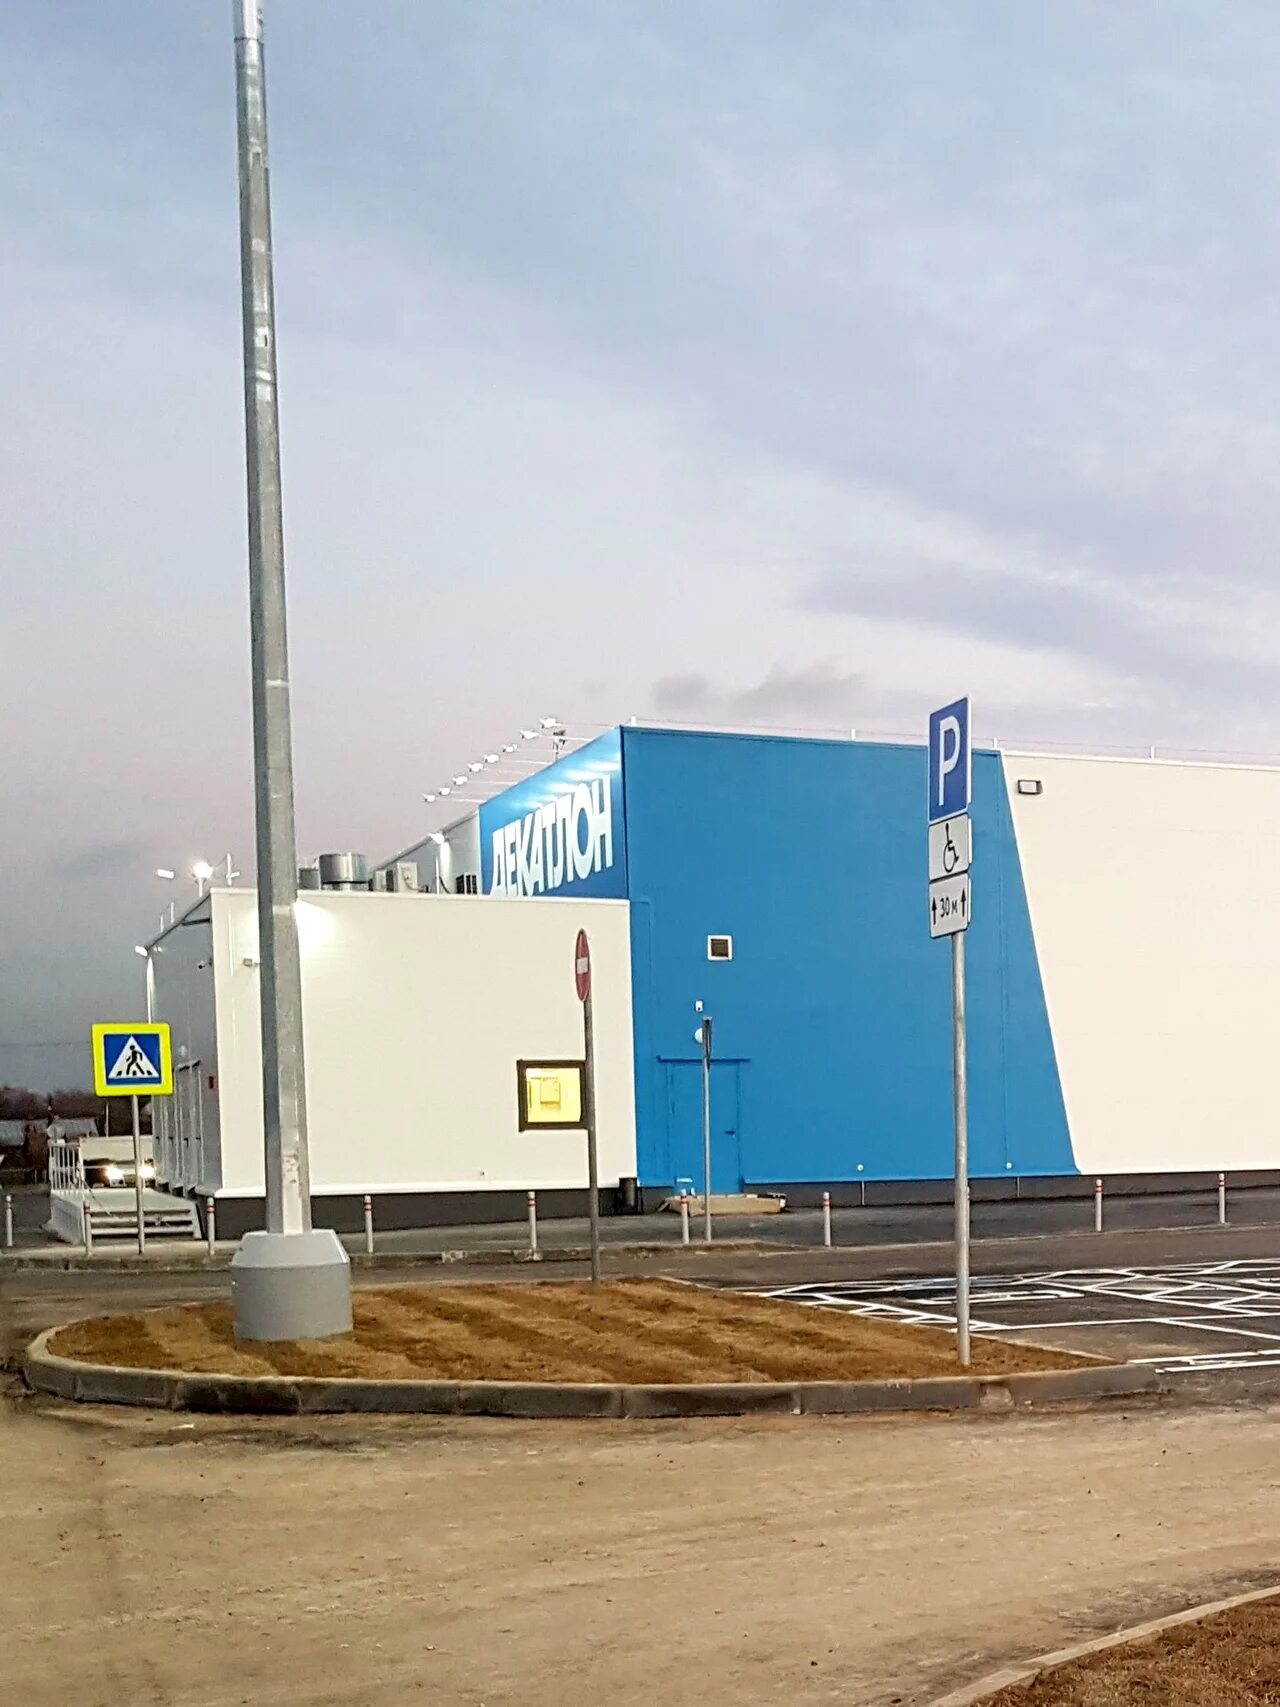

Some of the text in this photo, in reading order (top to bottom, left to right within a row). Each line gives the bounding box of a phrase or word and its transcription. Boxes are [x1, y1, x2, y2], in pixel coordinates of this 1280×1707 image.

[939, 715, 960, 806] P
[490, 774, 613, 896] ДЕКАТЛОН
[940, 896, 950, 917] 30
